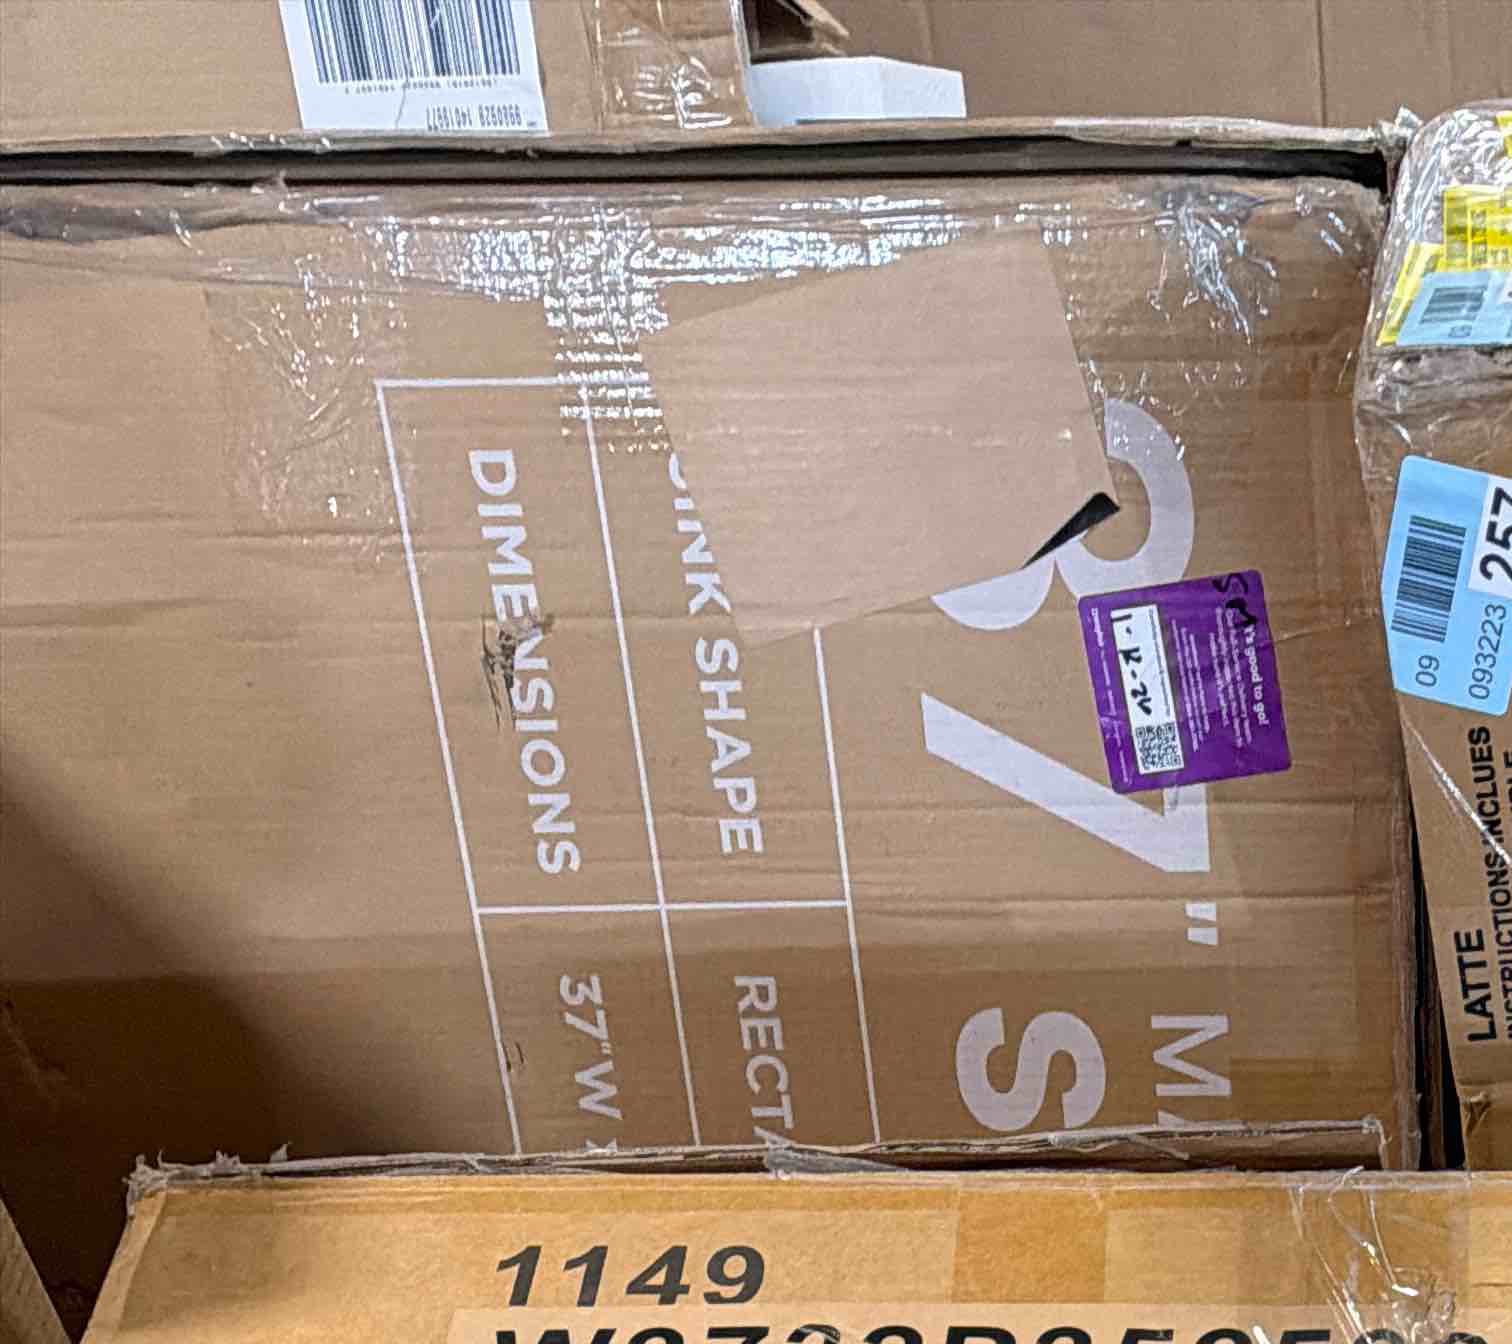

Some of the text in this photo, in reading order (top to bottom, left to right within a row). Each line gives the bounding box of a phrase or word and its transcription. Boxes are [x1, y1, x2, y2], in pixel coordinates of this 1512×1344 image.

[468, 449, 582, 874] DIMENSIONS
[1244, 647, 1263, 683] good
[1415, 655, 1440, 687] 09
[1468, 603, 1507, 699] 093223
[1252, 685, 1264, 700] to
[1253, 701, 1269, 724] go!
[695, 637, 764, 854] SHAPE
[1454, 928, 1497, 1042] LATTE
[496, 1244, 766, 1307] 1149
